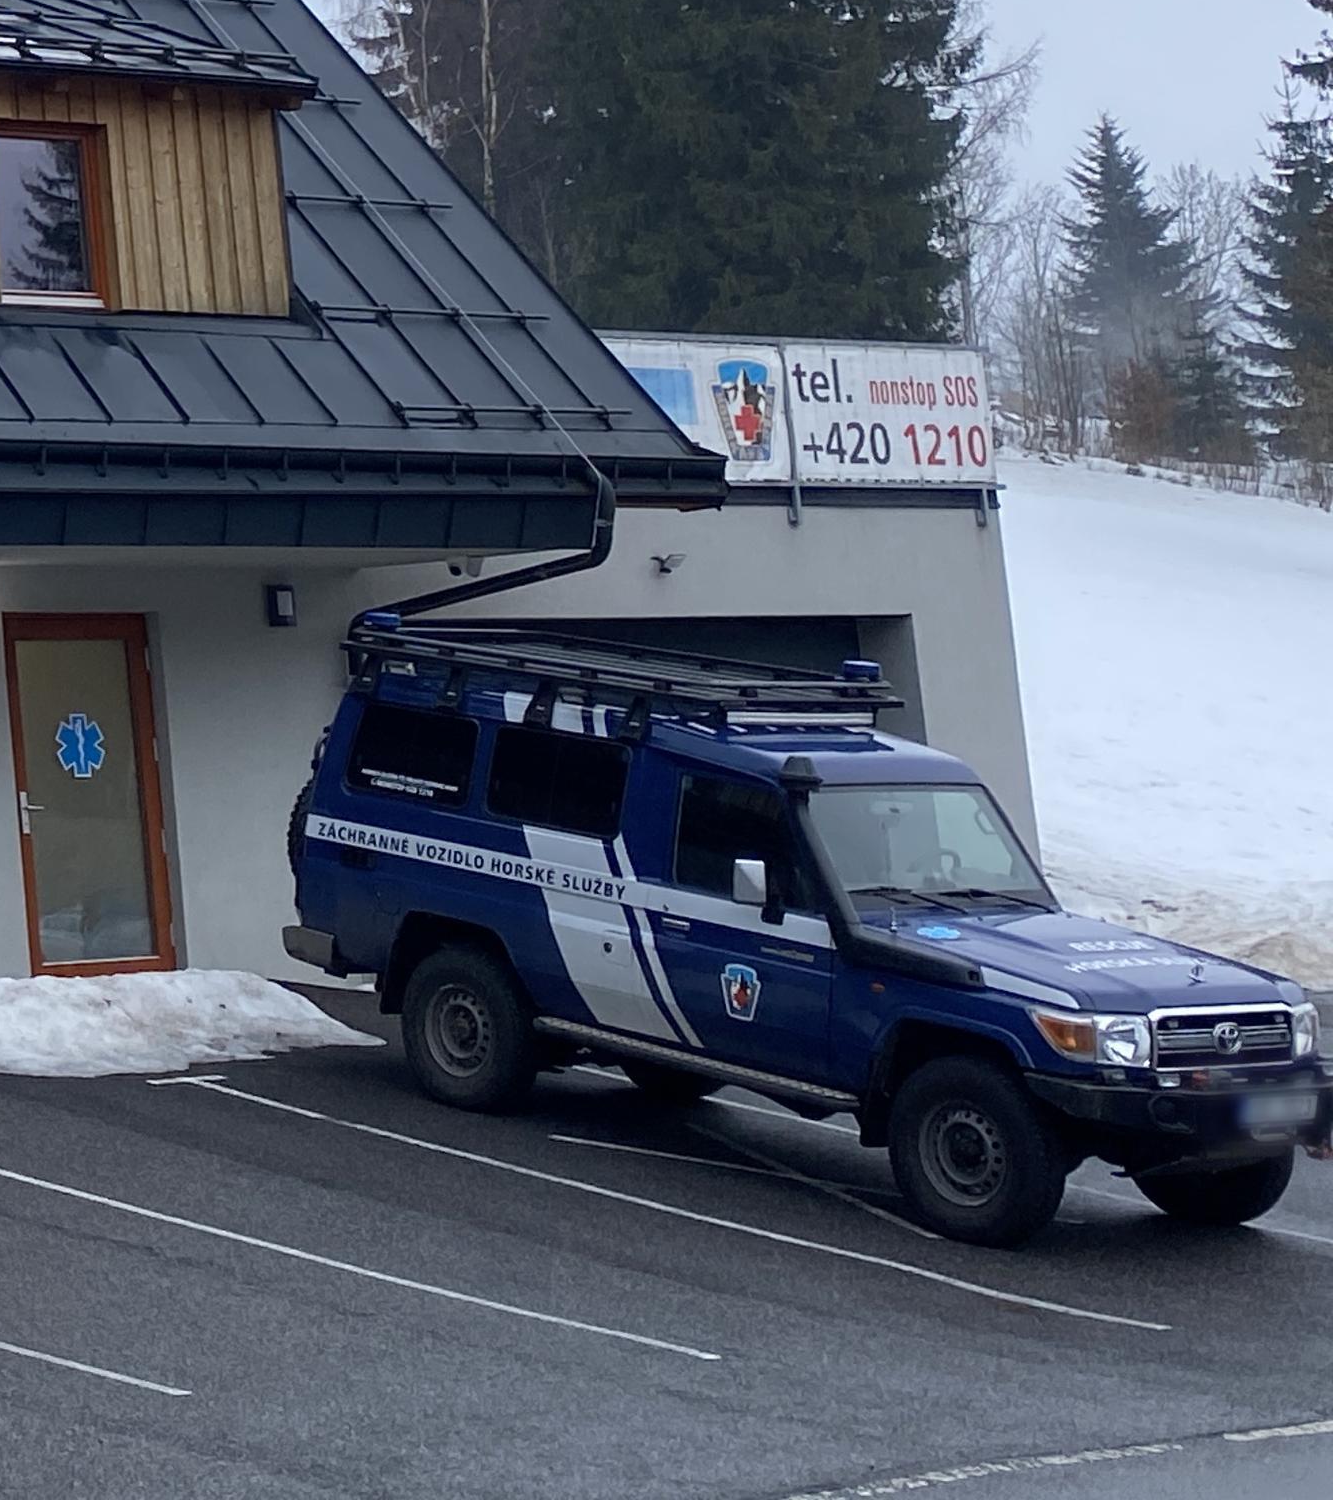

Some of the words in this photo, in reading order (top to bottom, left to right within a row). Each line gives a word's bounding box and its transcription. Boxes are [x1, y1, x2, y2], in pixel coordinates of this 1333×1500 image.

[792, 358, 853, 404] tel.
[869, 375, 937, 412] nonstop
[942, 375, 979, 408] SOS
[802, 421, 891, 465] +420
[903, 423, 987, 468] 1210
[318, 821, 410, 854] ZÁCHRANNÉ
[416, 843, 484, 869] VOZIDLO
[491, 857, 556, 885] HORSKÉ
[562, 873, 626, 900] SLUŽBY
